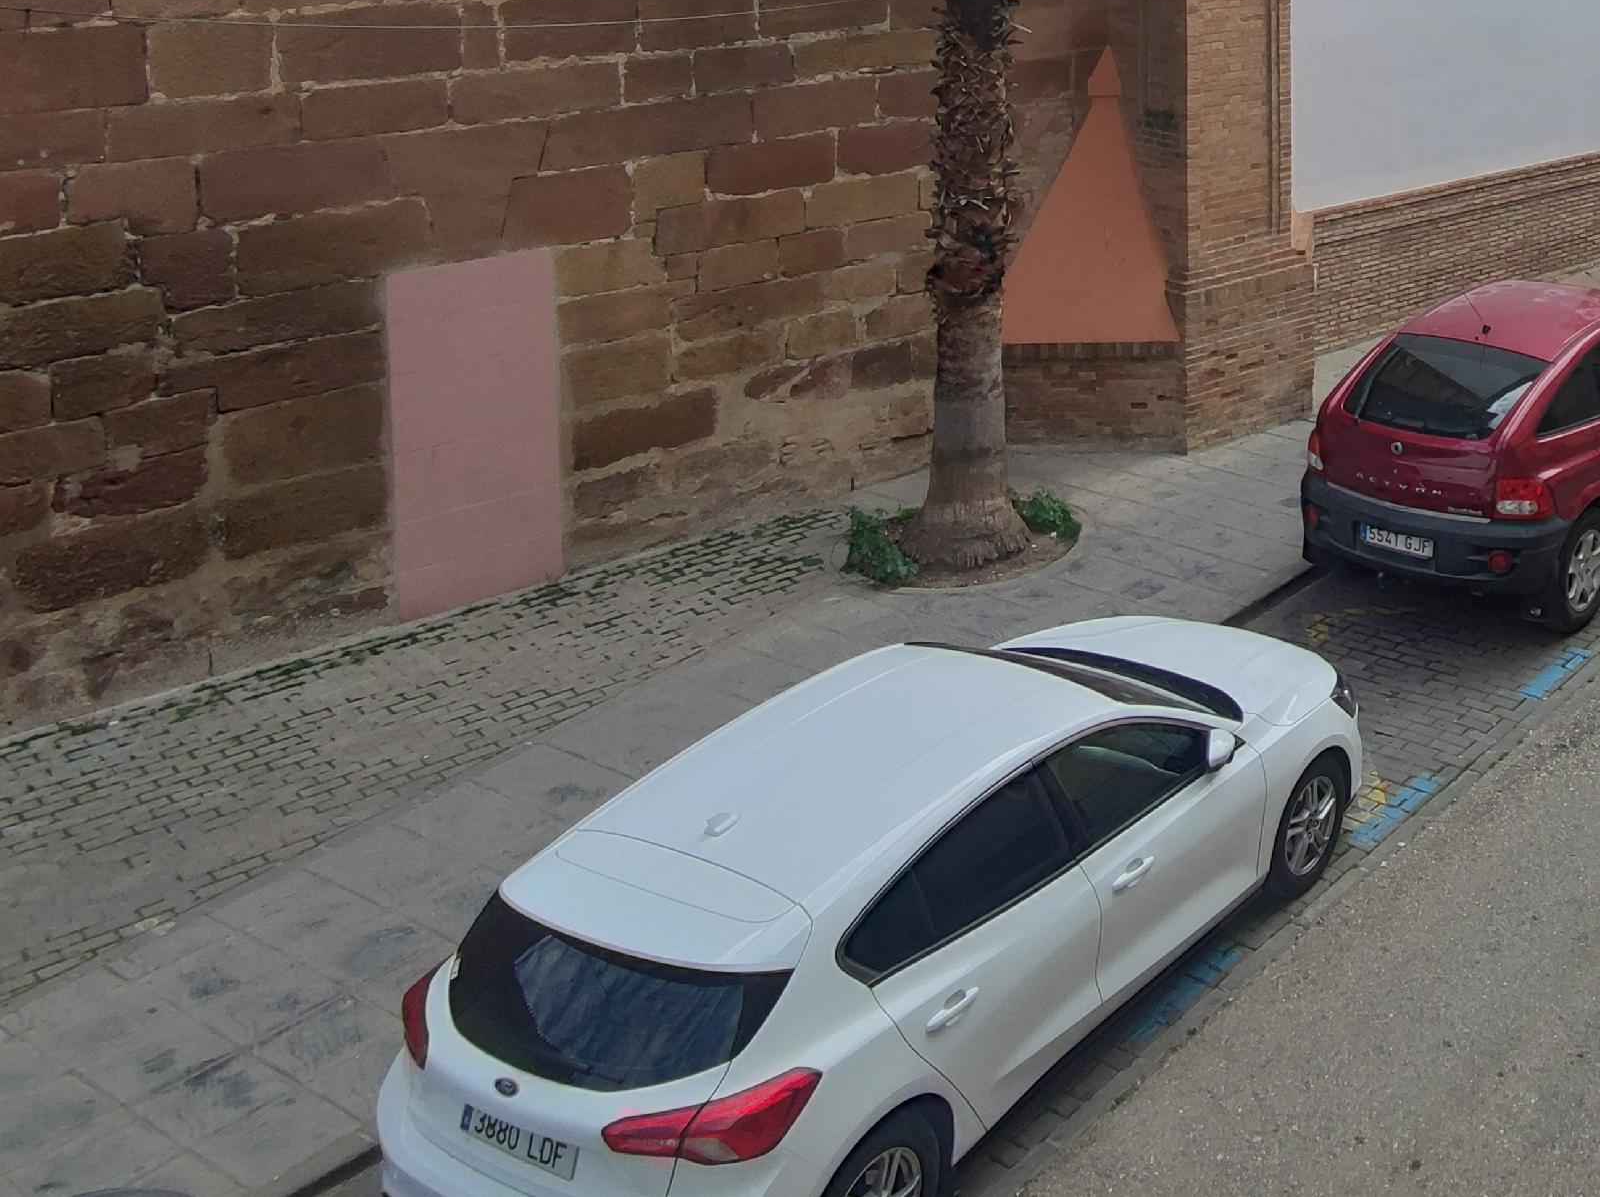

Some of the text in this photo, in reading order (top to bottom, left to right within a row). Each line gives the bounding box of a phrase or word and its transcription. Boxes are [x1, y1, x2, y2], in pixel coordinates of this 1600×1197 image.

[1369, 529, 1430, 554] 5541 GJF
[474, 1113, 567, 1169] 3880 LDF
